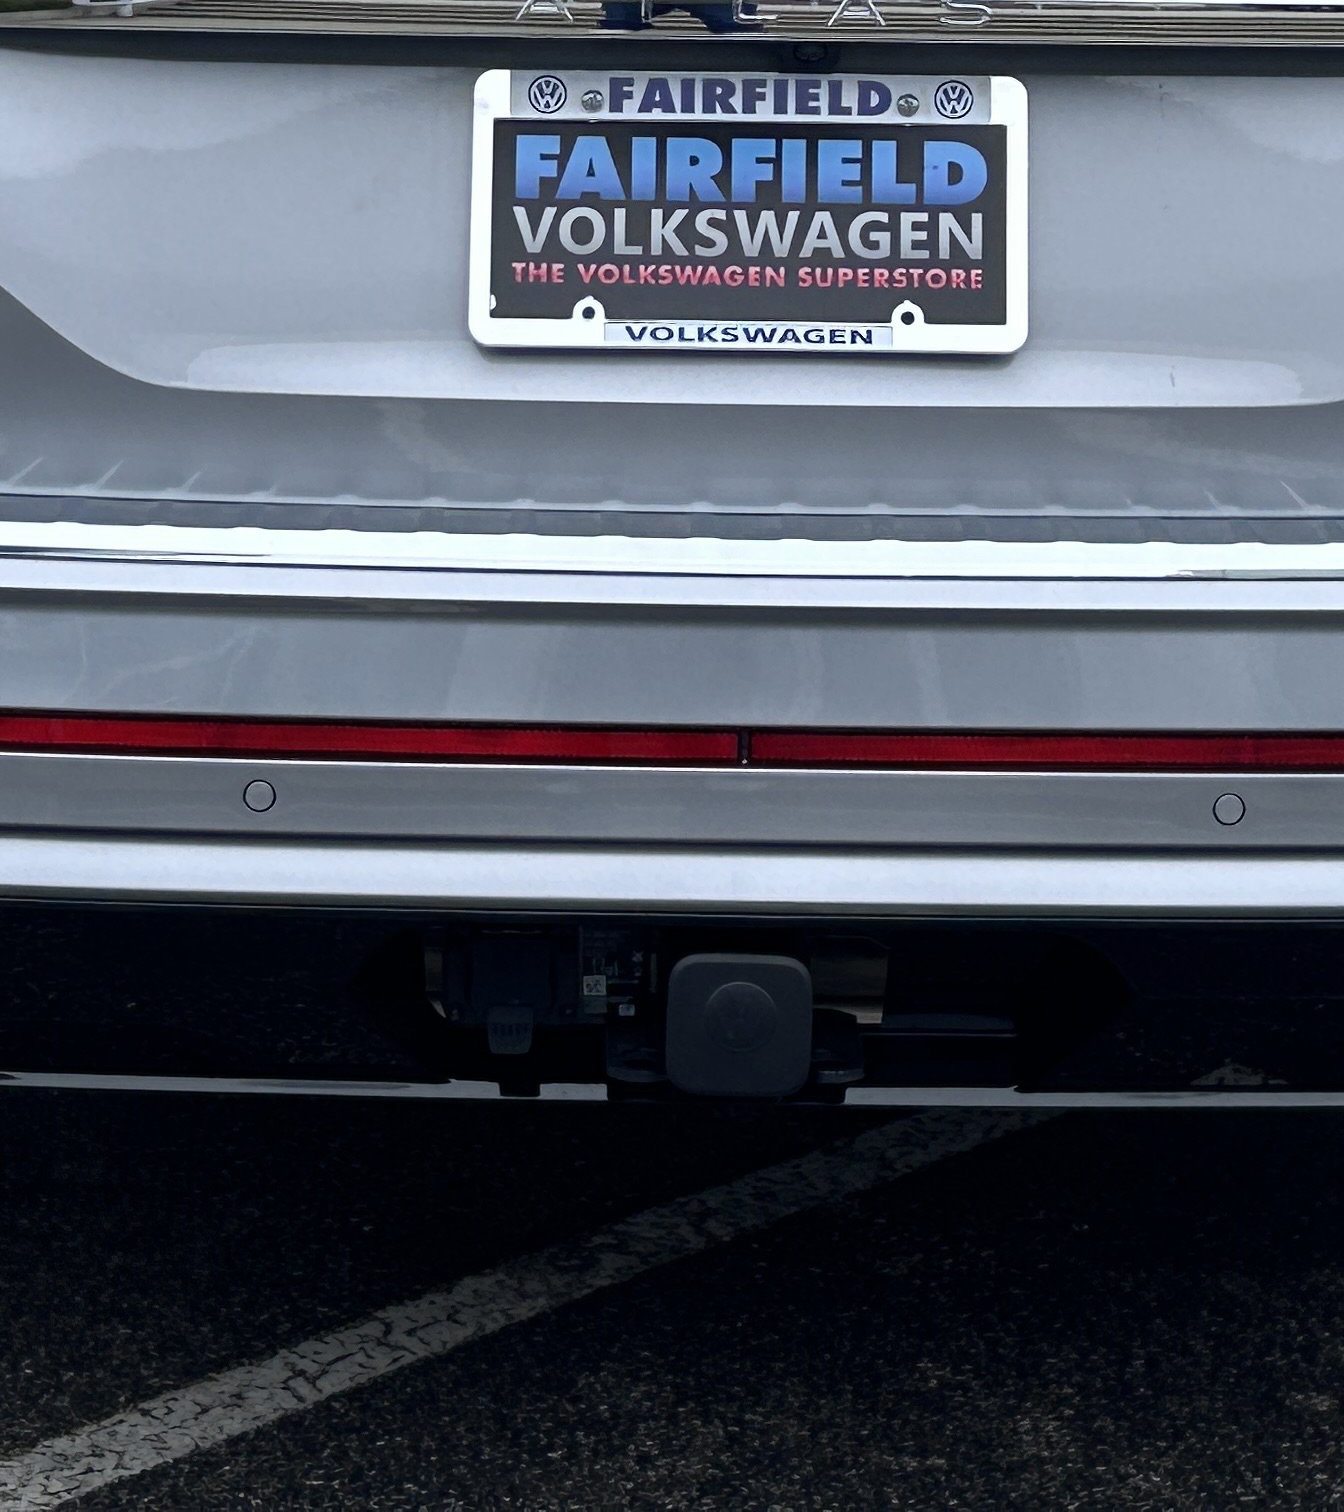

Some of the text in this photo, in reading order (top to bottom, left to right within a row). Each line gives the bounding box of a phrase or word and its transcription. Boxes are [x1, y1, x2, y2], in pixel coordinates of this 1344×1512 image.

[608, 76, 893, 117] FAIRFIELD
[514, 134, 988, 206] FAIRFIELD
[512, 206, 984, 260] VOLKSWAGEN
[511, 262, 984, 290] THE VOLKSWAGEN SUPERSTORE
[624, 325, 873, 346] VOLKSWAGEN
